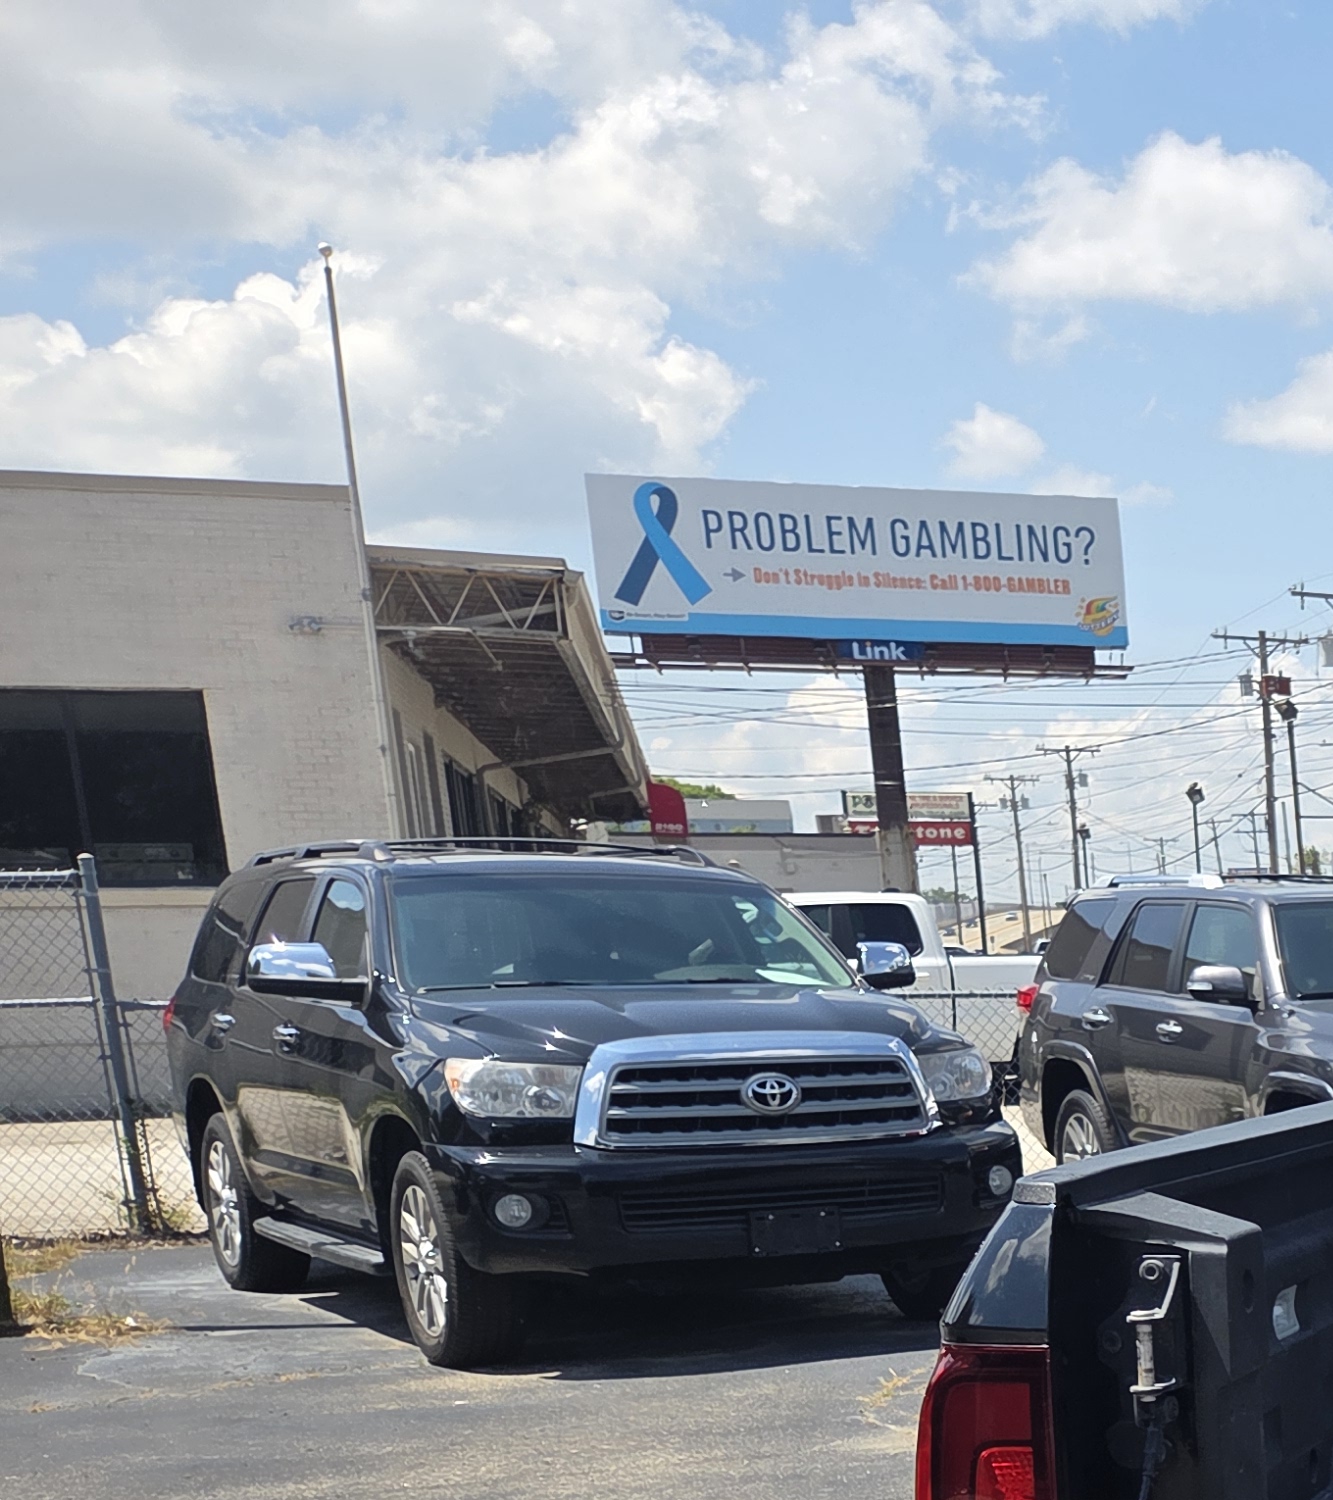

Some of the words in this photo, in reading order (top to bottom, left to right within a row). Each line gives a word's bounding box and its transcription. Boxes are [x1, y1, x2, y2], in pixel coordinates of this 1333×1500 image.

[702, 510, 877, 556] PROBLEM
[890, 518, 1095, 565] GAMBLING?
[753, 567, 790, 584] Don't
[794, 568, 854, 590] Struggle
[930, 573, 958, 590] Call
[961, 575, 1071, 595] 1-800-GAMBLER
[852, 641, 909, 660] Link
